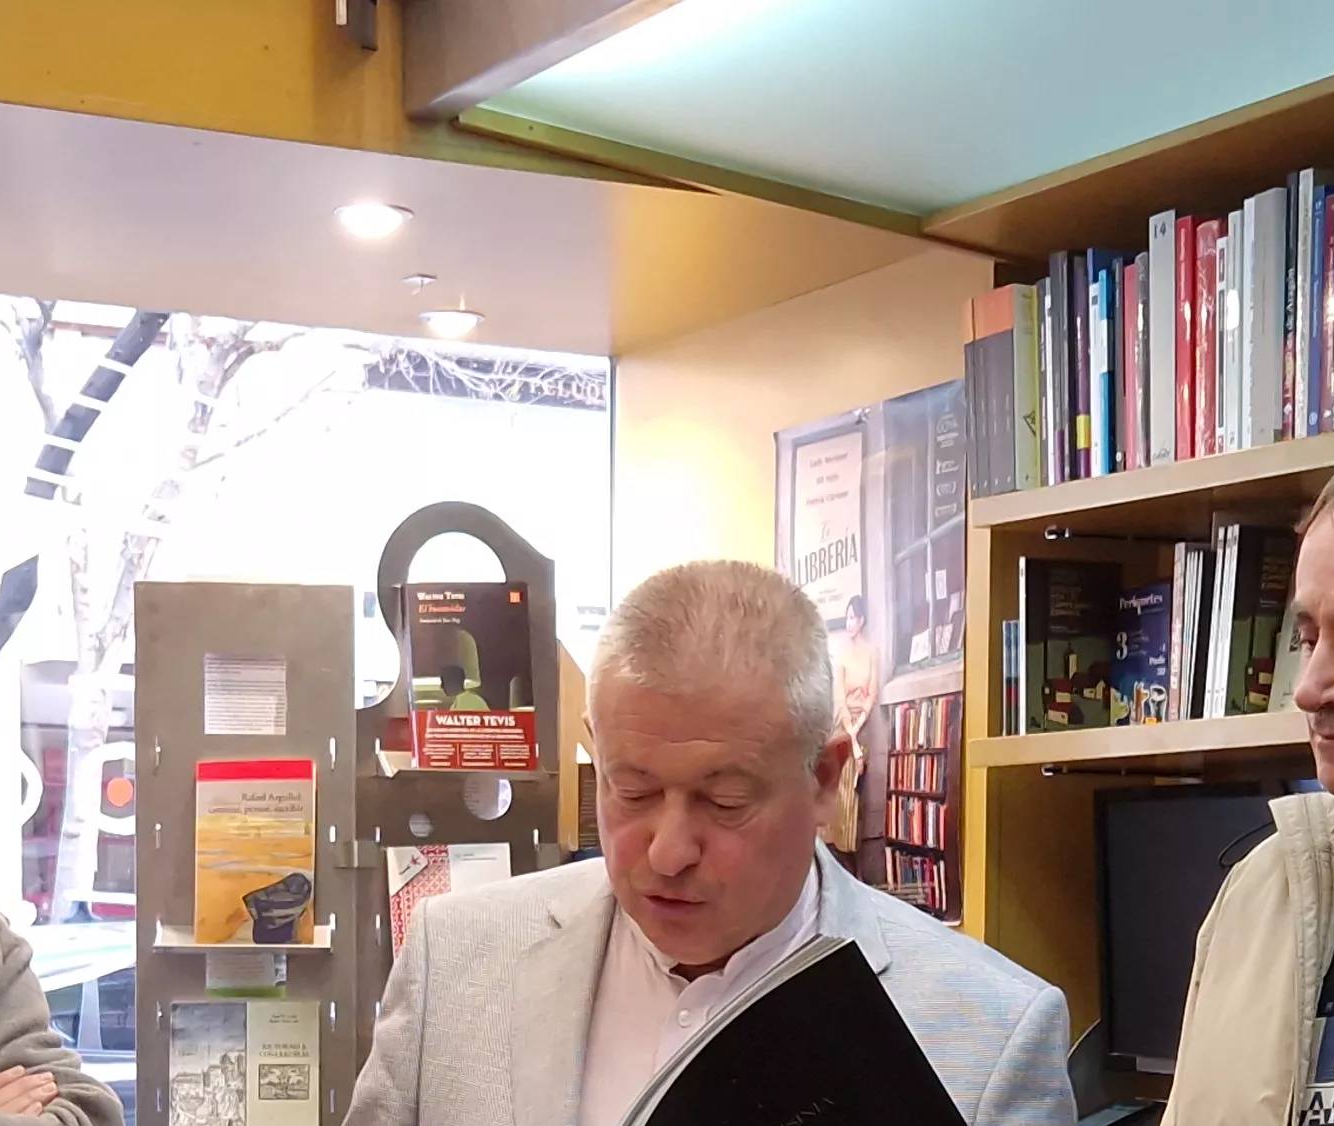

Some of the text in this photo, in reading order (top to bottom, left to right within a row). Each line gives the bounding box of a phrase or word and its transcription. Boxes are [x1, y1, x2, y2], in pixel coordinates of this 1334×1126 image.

[797, 526, 858, 587] LIBRERÍA
[1116, 631, 1127, 660] 3
[436, 715, 516, 727] WALTER TEVIS
